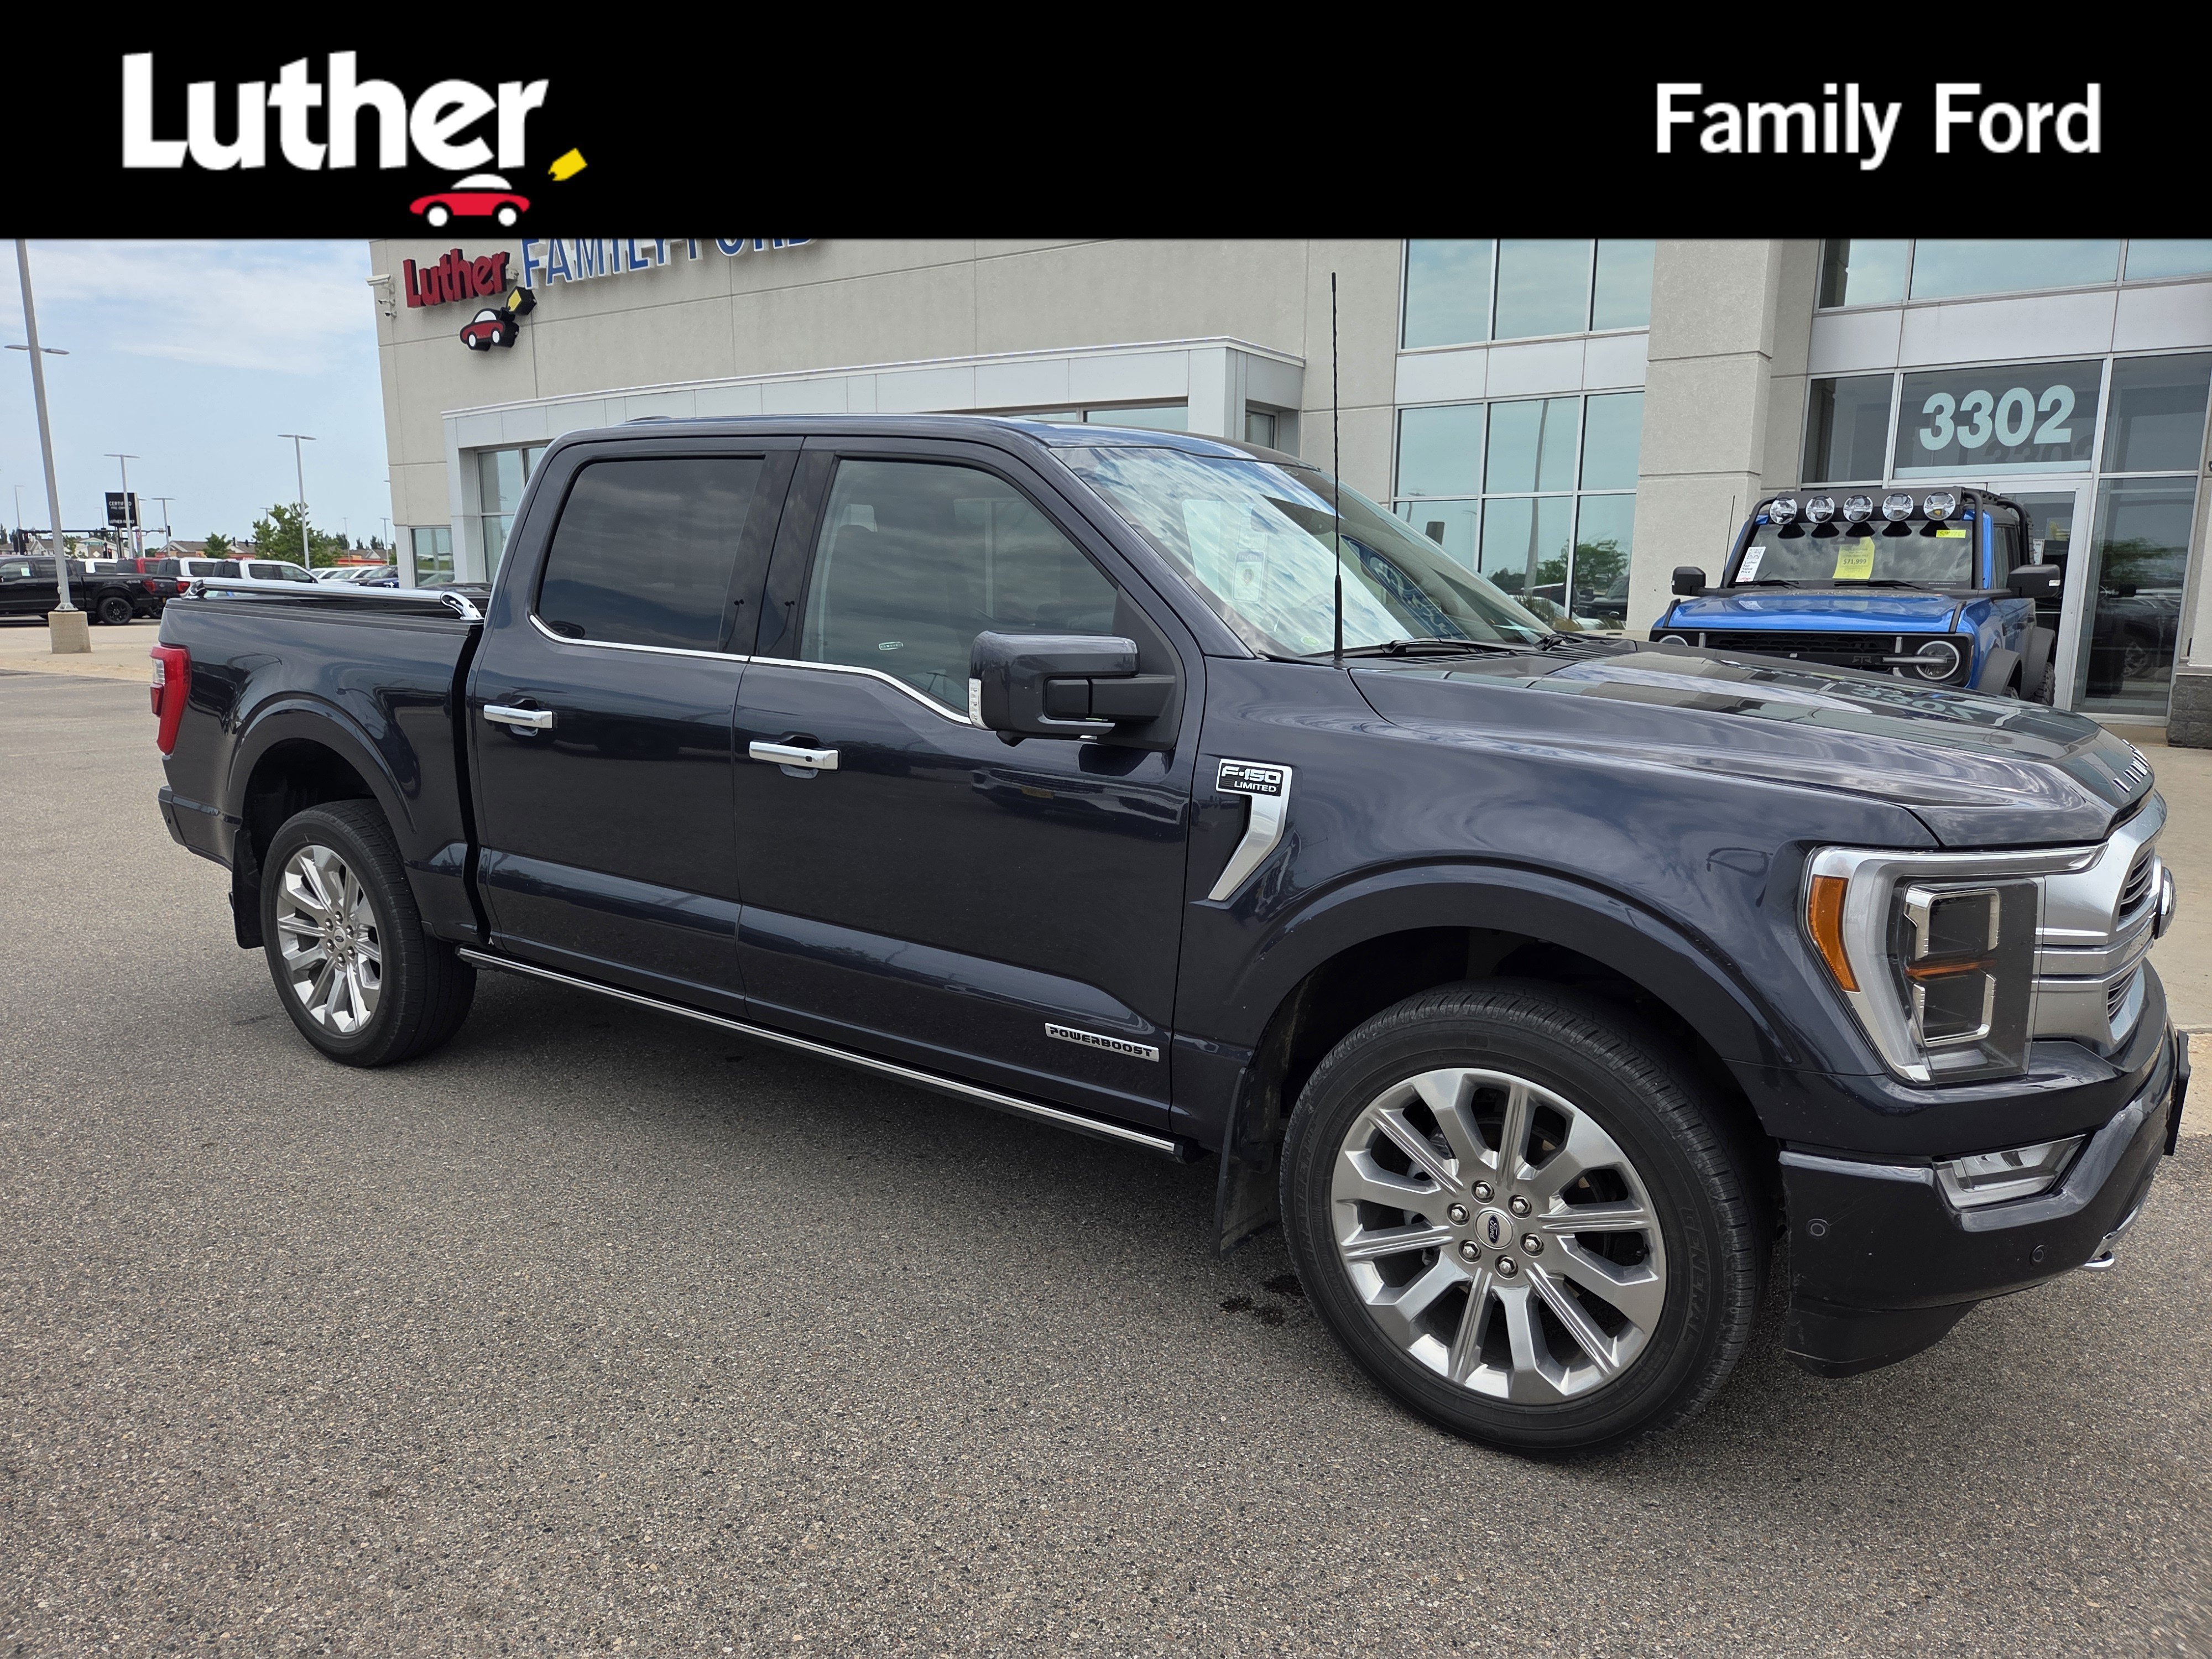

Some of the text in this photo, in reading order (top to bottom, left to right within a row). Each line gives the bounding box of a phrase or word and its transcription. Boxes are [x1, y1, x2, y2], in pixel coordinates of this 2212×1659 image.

[403, 248, 510, 308] Luther
[1919, 385, 2075, 451] 3302
[1221, 765, 1282, 784] F-150
[1234, 780, 1277, 793] LIMITED
[1050, 1026, 1152, 1057] POWERBOOST
[1489, 1220, 1499, 1240] Ford
